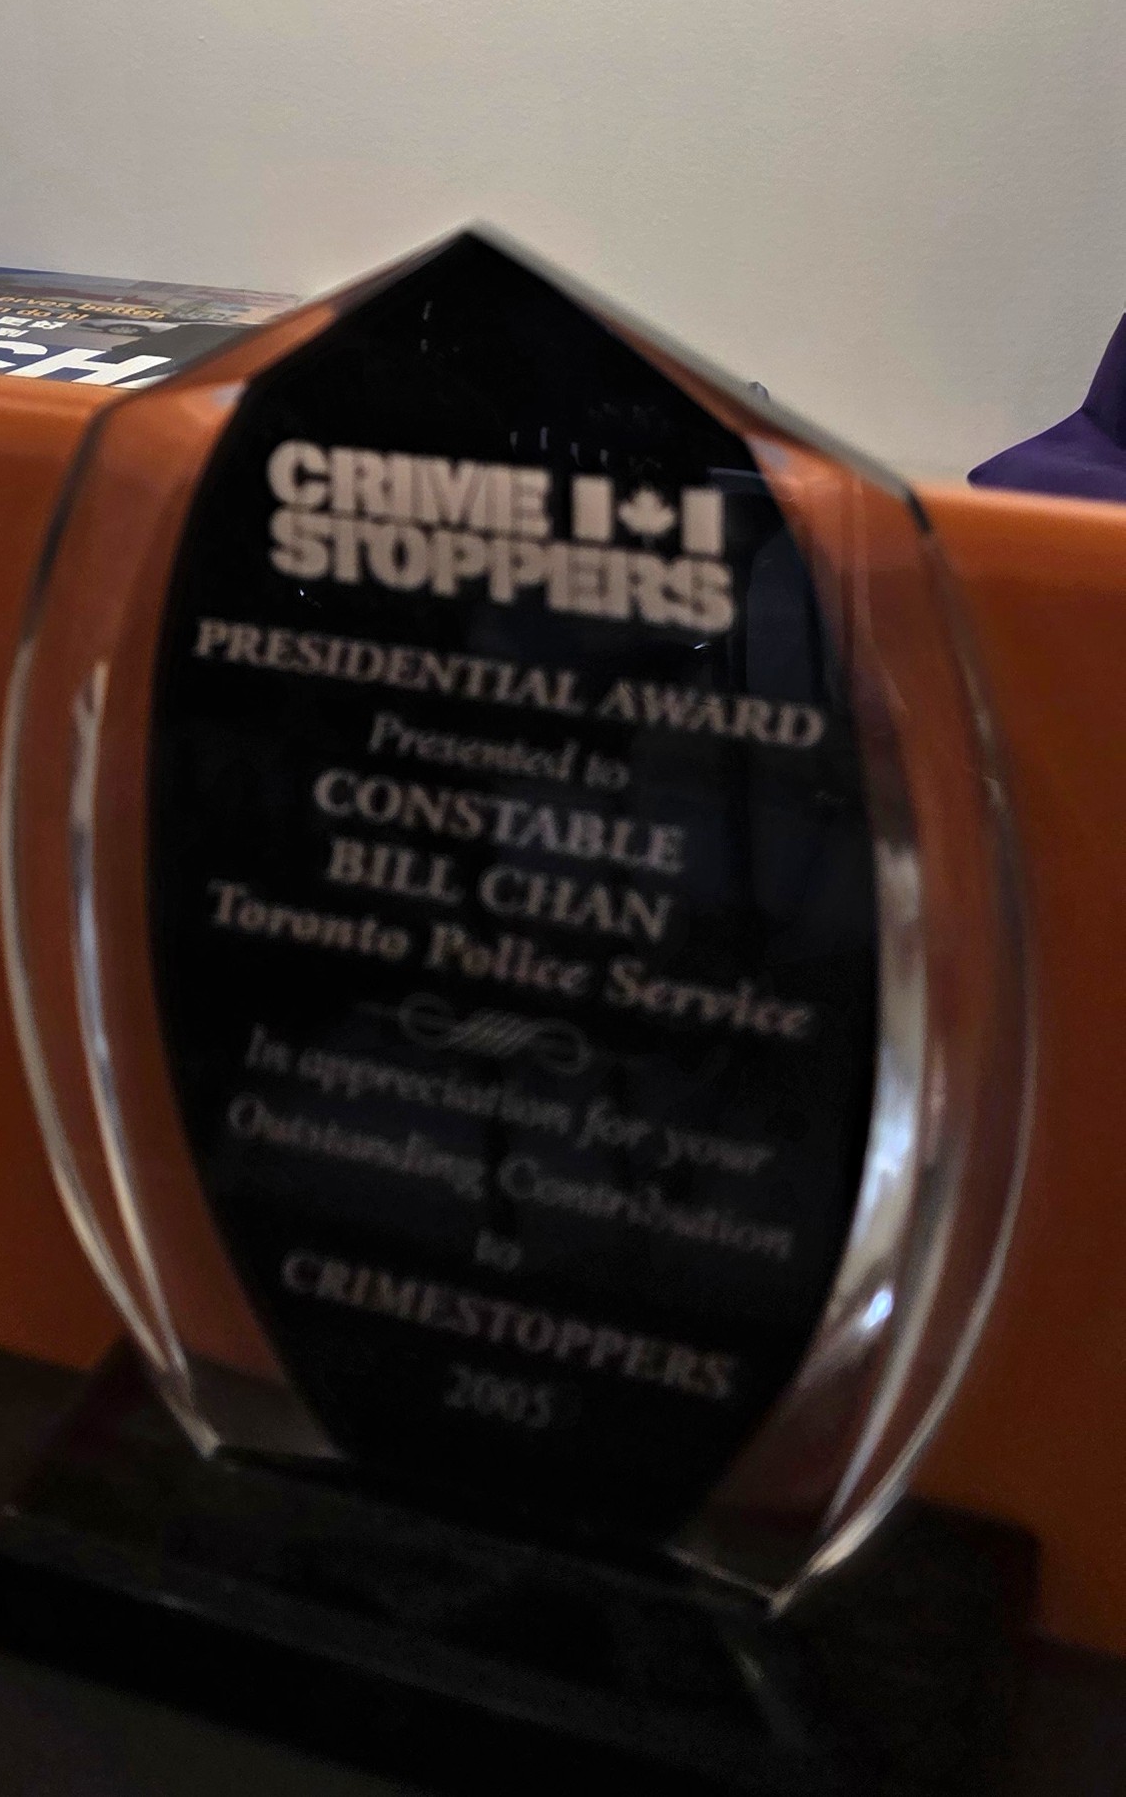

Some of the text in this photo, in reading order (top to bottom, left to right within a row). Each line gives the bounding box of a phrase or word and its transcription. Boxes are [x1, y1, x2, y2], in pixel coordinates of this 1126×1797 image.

[16, 306, 53, 319] do
[56, 311, 90, 323] it!
[266, 439, 553, 539] CRIME
[268, 508, 735, 635] STOPPERS
[193, 616, 827, 750] PRESIDENTIAL AWARD
[370, 711, 632, 792] Presented to
[314, 768, 686, 874] CONSTABLE
[324, 837, 673, 943] BILL CHAN
[207, 877, 813, 1040] Toronto Police Service
[246, 1023, 775, 1176] In appreciation for your
[228, 1092, 795, 1263] Outstanding Contribution
[281, 1249, 736, 1401] CRIMESTOPPERS
[444, 1363, 556, 1433] 2005
